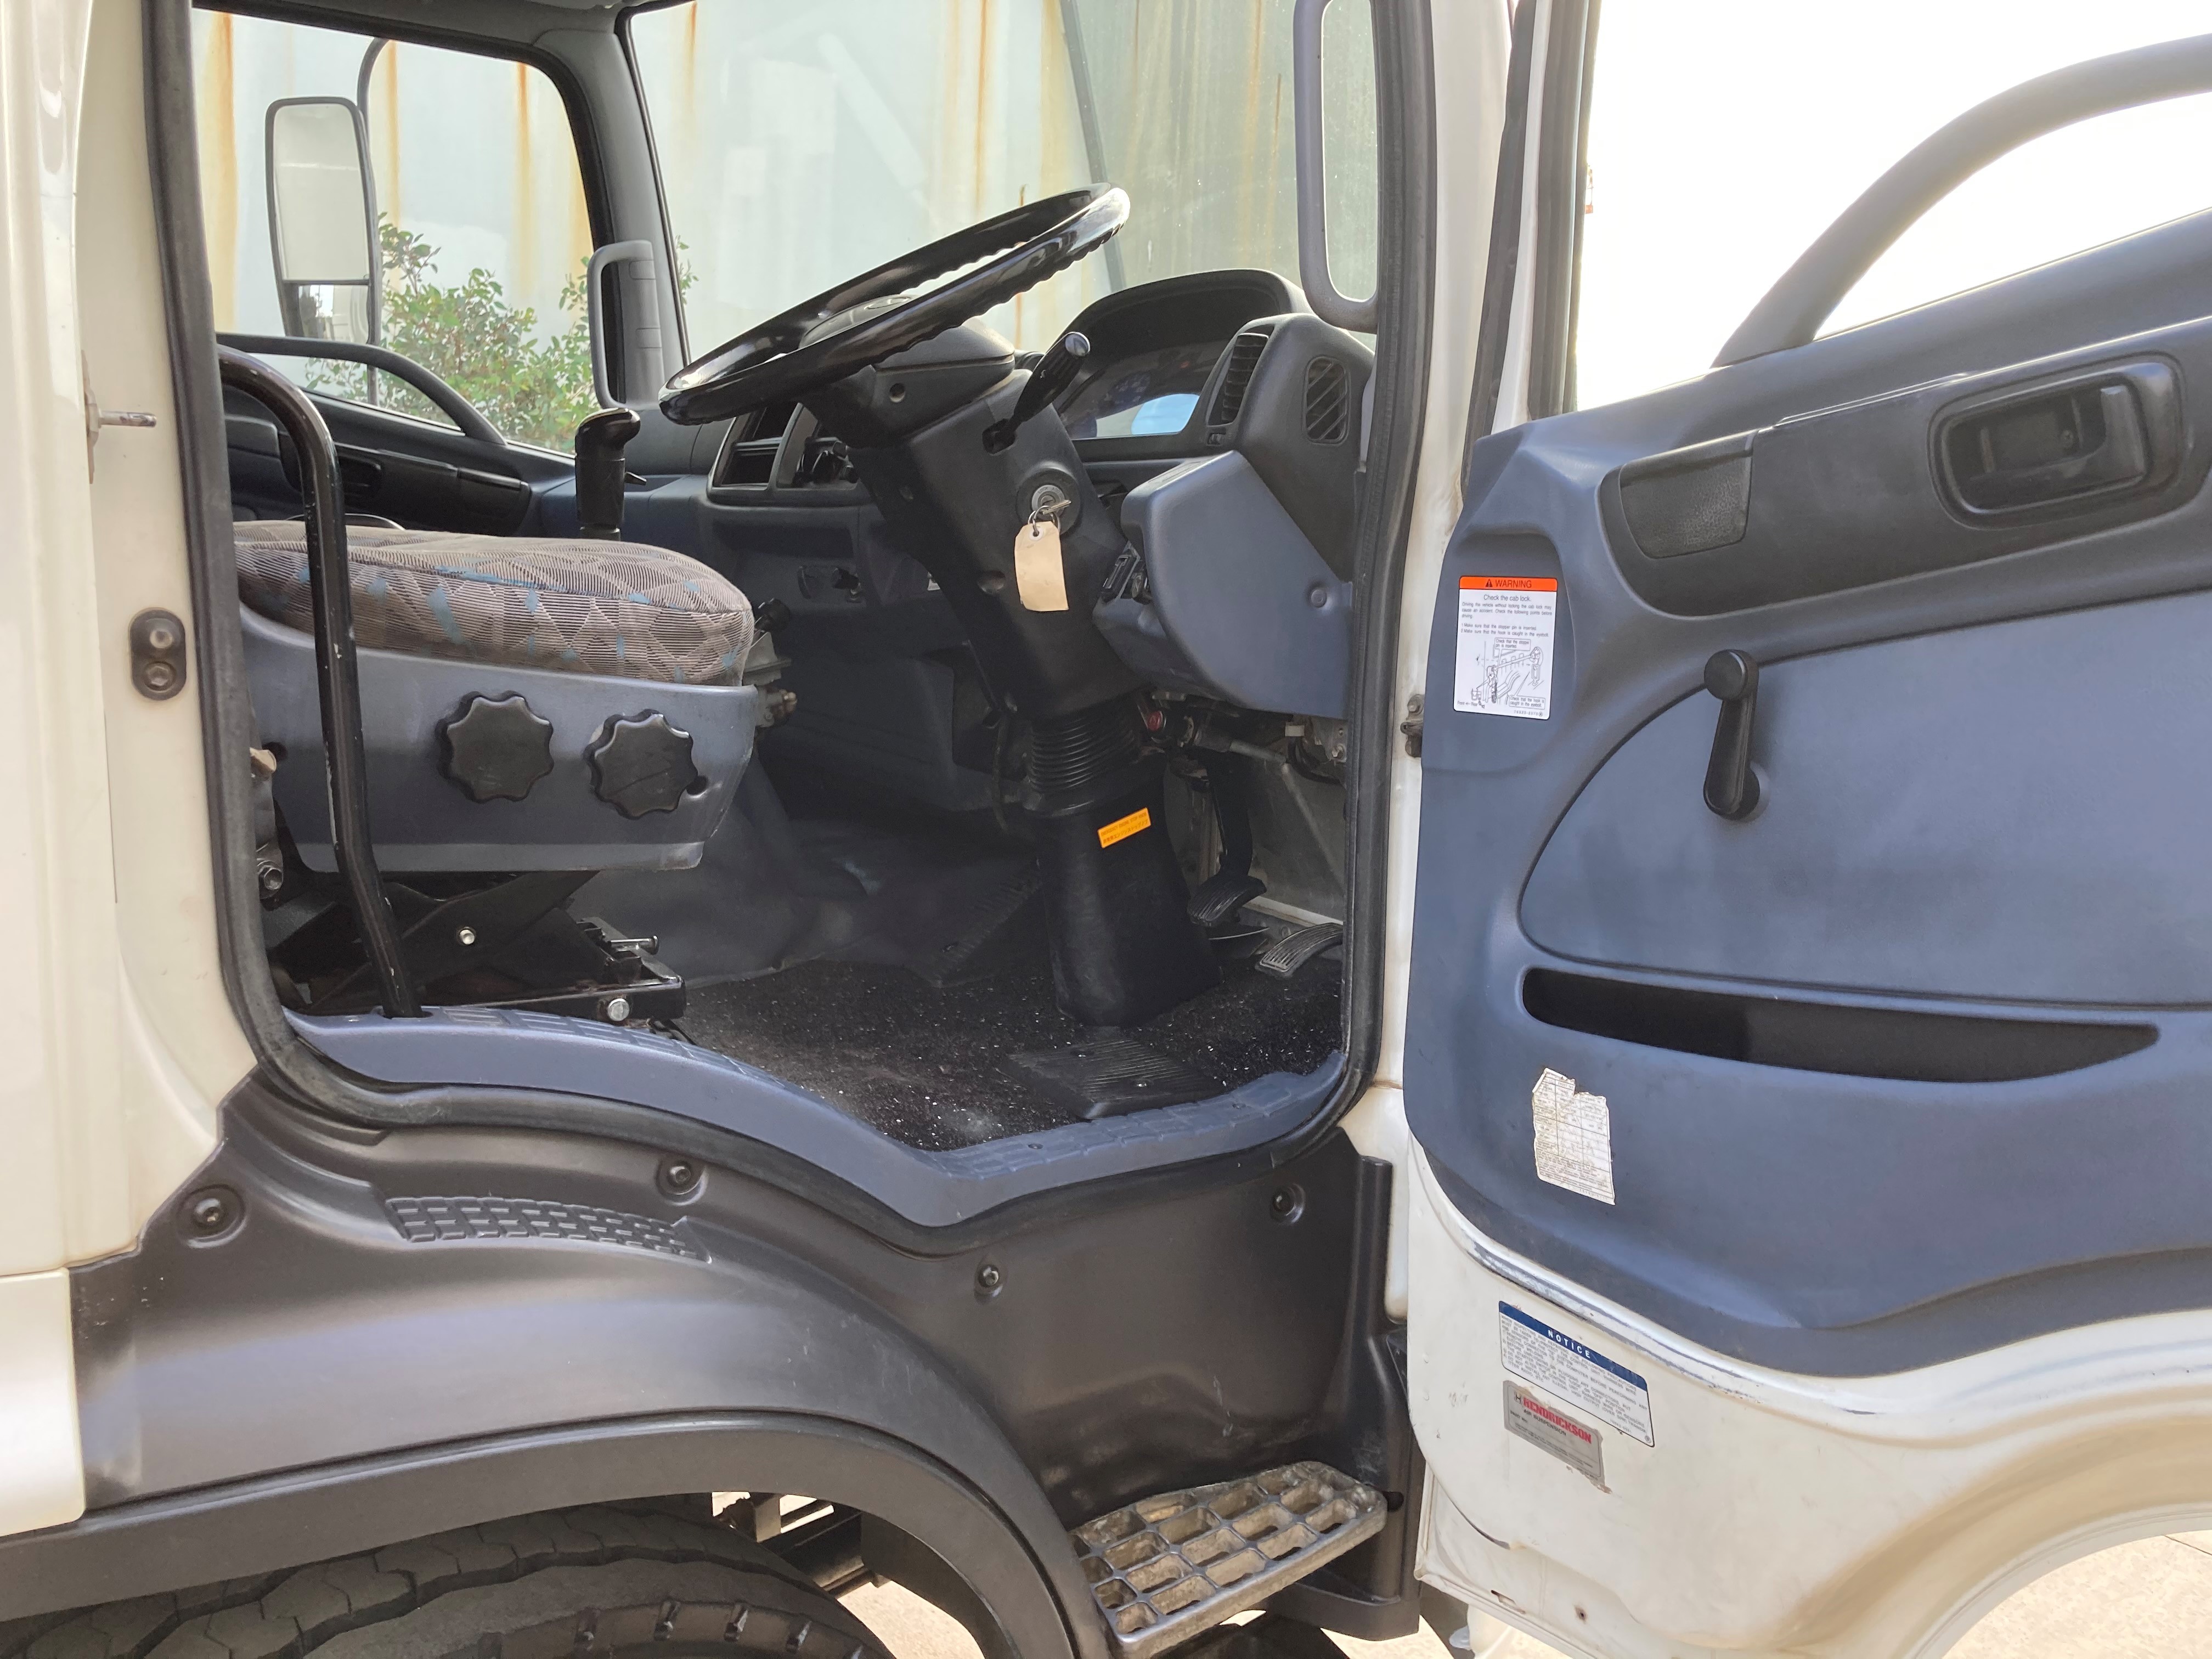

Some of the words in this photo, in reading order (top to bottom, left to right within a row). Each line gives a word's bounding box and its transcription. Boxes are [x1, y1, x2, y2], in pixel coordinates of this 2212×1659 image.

[1496, 580, 1532, 588] WARNING
[1548, 1329, 1590, 1359] NOTICE
[1523, 1395, 1592, 1444] HENDRICKSON
[1533, 1414, 1566, 1436] SUSPENSION
